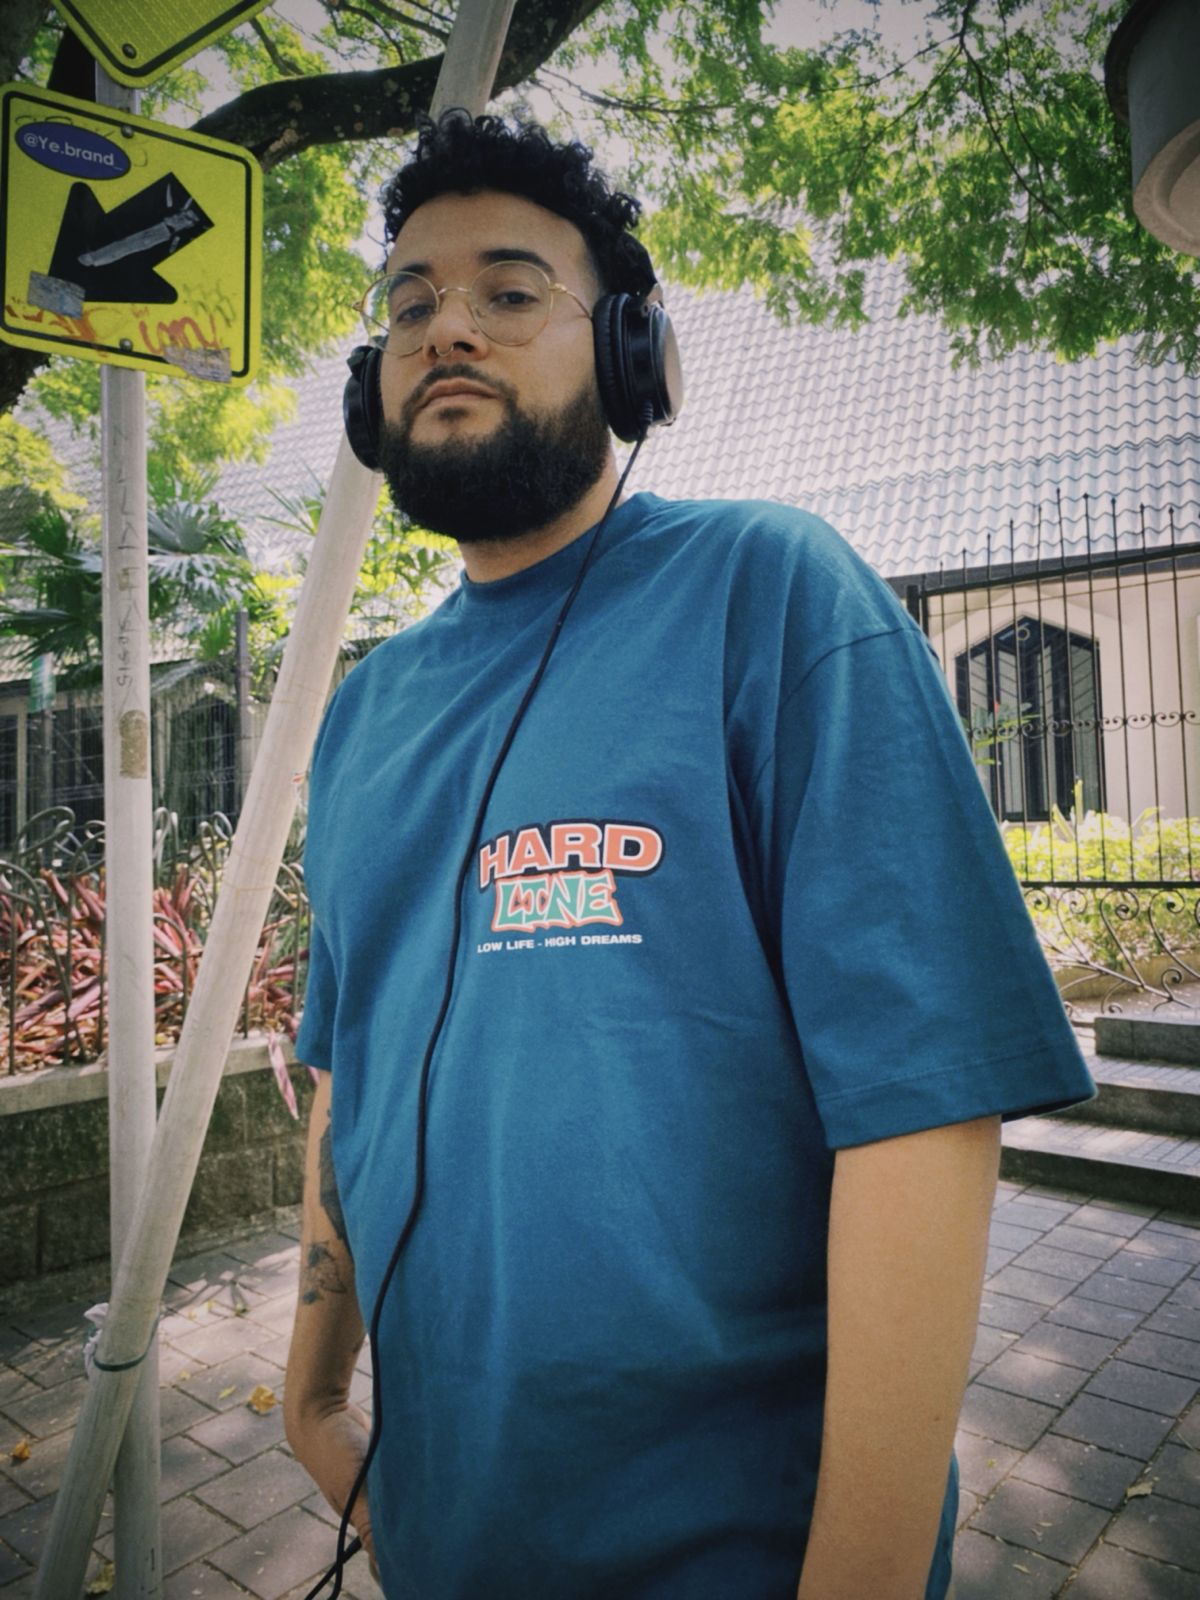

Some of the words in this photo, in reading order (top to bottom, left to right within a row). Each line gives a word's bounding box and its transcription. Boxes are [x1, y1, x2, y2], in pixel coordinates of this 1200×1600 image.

[478, 821, 665, 890] HARD
[492, 870, 623, 932] LINE
[477, 941, 502, 953] LOW
[506, 939, 535, 951] LIFE
[544, 936, 576, 947] HIGH
[580, 934, 643, 946] DREAMS
